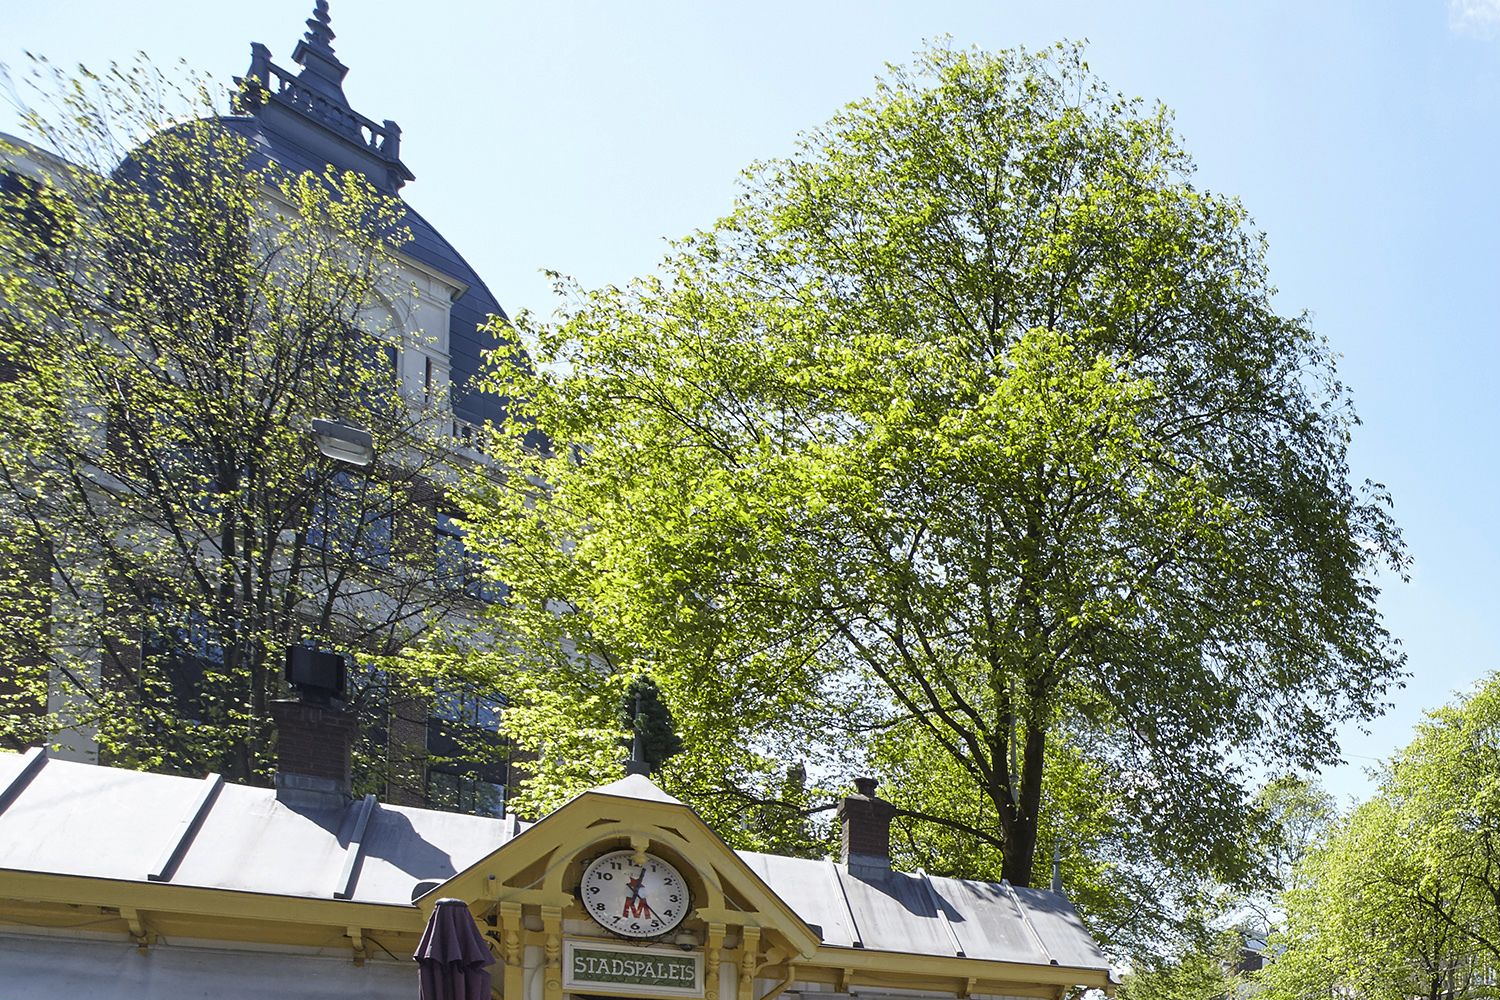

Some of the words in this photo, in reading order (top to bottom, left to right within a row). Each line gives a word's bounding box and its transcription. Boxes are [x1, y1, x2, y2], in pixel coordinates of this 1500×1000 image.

[610, 862, 622, 870] 11
[596, 872, 613, 880] 10
[669, 895, 679, 903] 3
[596, 903, 606, 911] 8
[663, 909, 673, 917] 4
[612, 916, 621, 924] 7
[651, 920, 659, 928] 5
[630, 922, 640, 930] 6
[574, 956, 695, 981] STADSPALEIS
